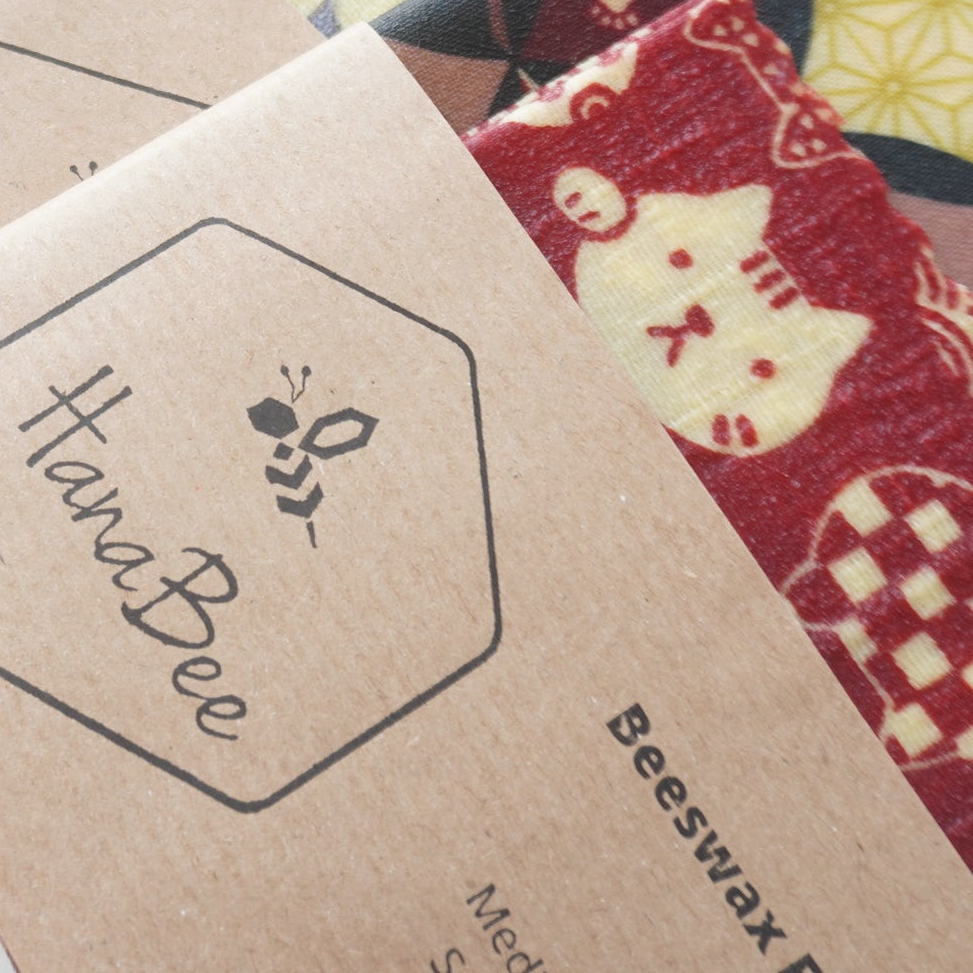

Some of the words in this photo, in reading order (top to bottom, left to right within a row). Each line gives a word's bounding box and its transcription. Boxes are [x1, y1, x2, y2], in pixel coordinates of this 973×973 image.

[18, 364, 247, 741] HanaBee
[466, 883, 548, 973] Med
[606, 702, 787, 955] Beeswax
